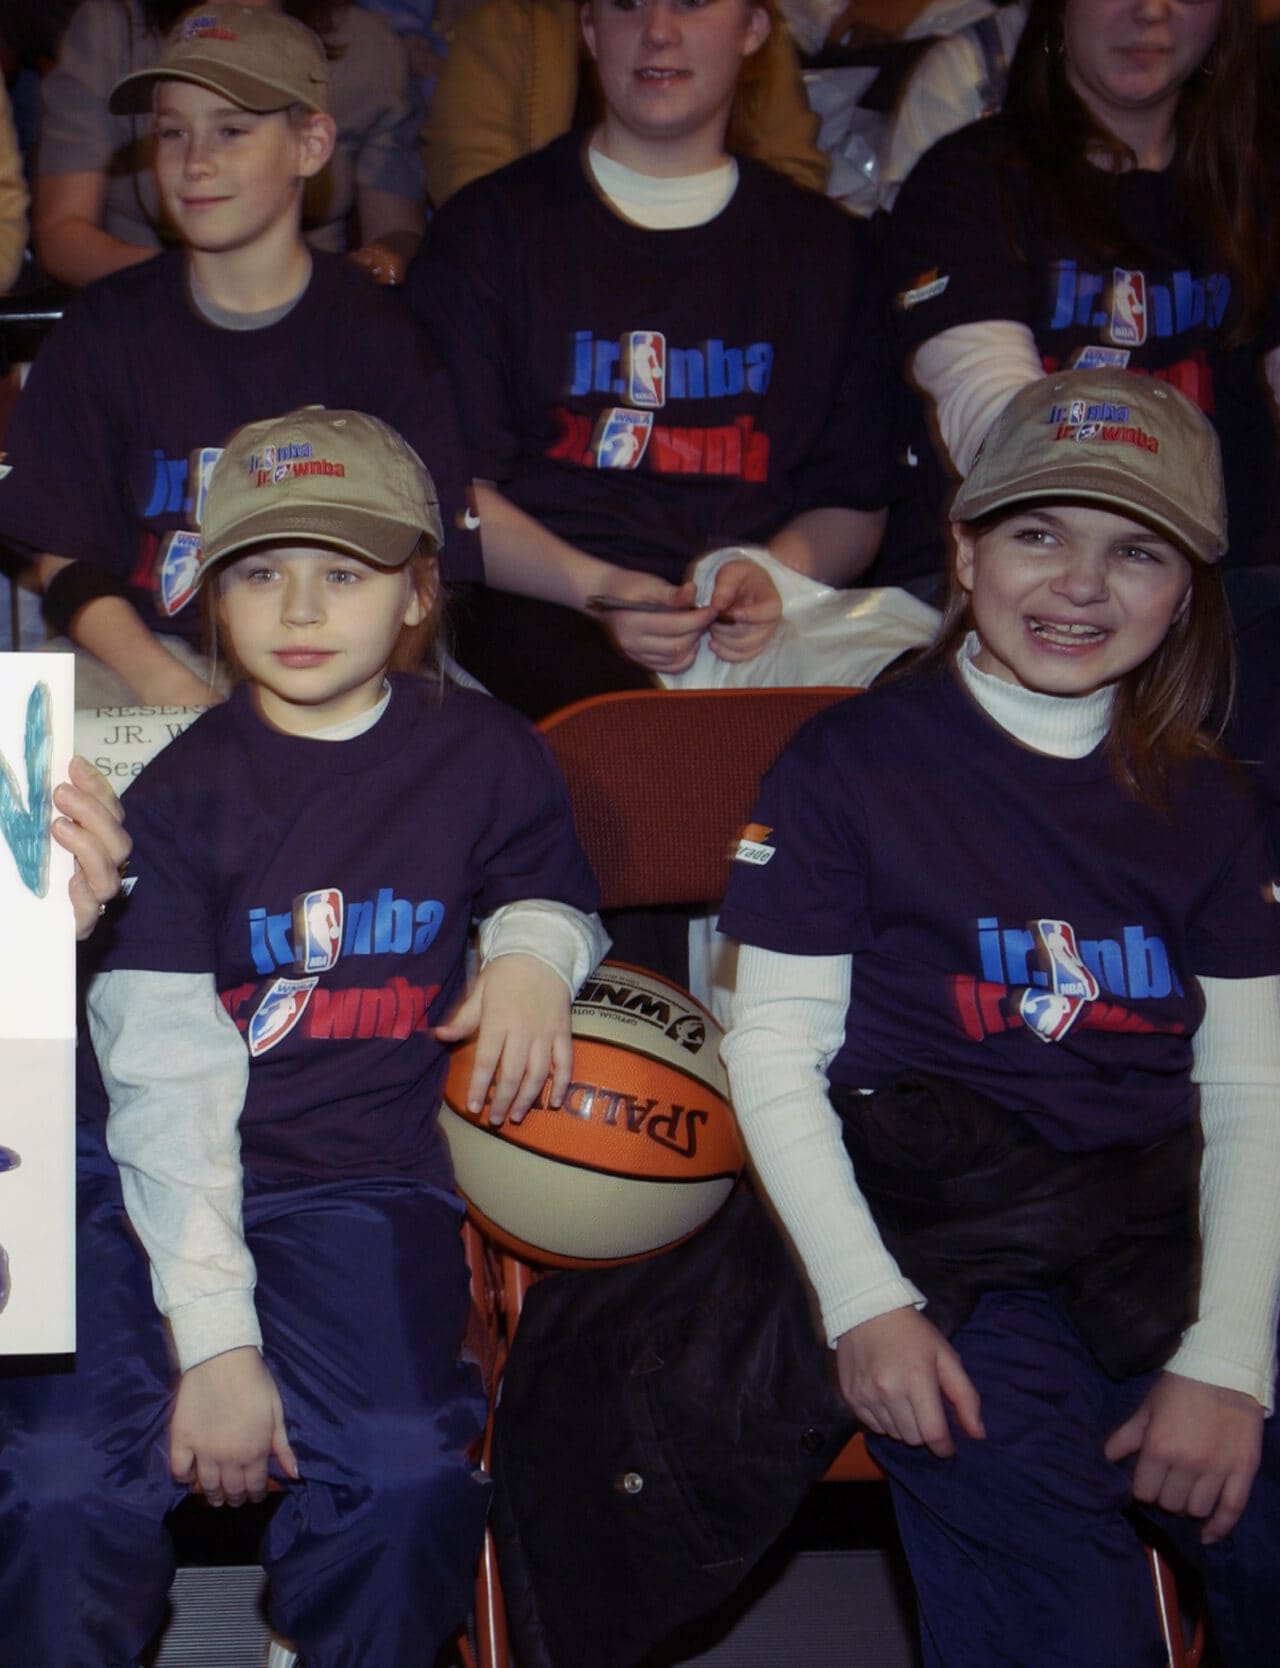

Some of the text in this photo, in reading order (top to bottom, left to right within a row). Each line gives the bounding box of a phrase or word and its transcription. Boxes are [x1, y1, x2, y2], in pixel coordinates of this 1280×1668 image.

[570, 330, 773, 399] jr. nba
[1087, 402, 1130, 423] nba
[277, 442, 313, 462] nba
[1102, 425, 1158, 454] wnba
[293, 459, 345, 478] wnba
[144, 449, 193, 517] jr.
[104, 725, 153, 745] JR.
[249, 888, 445, 975] jr. nba
[977, 917, 1185, 999] jr. nb
[1060, 982, 1085, 996] NBA
